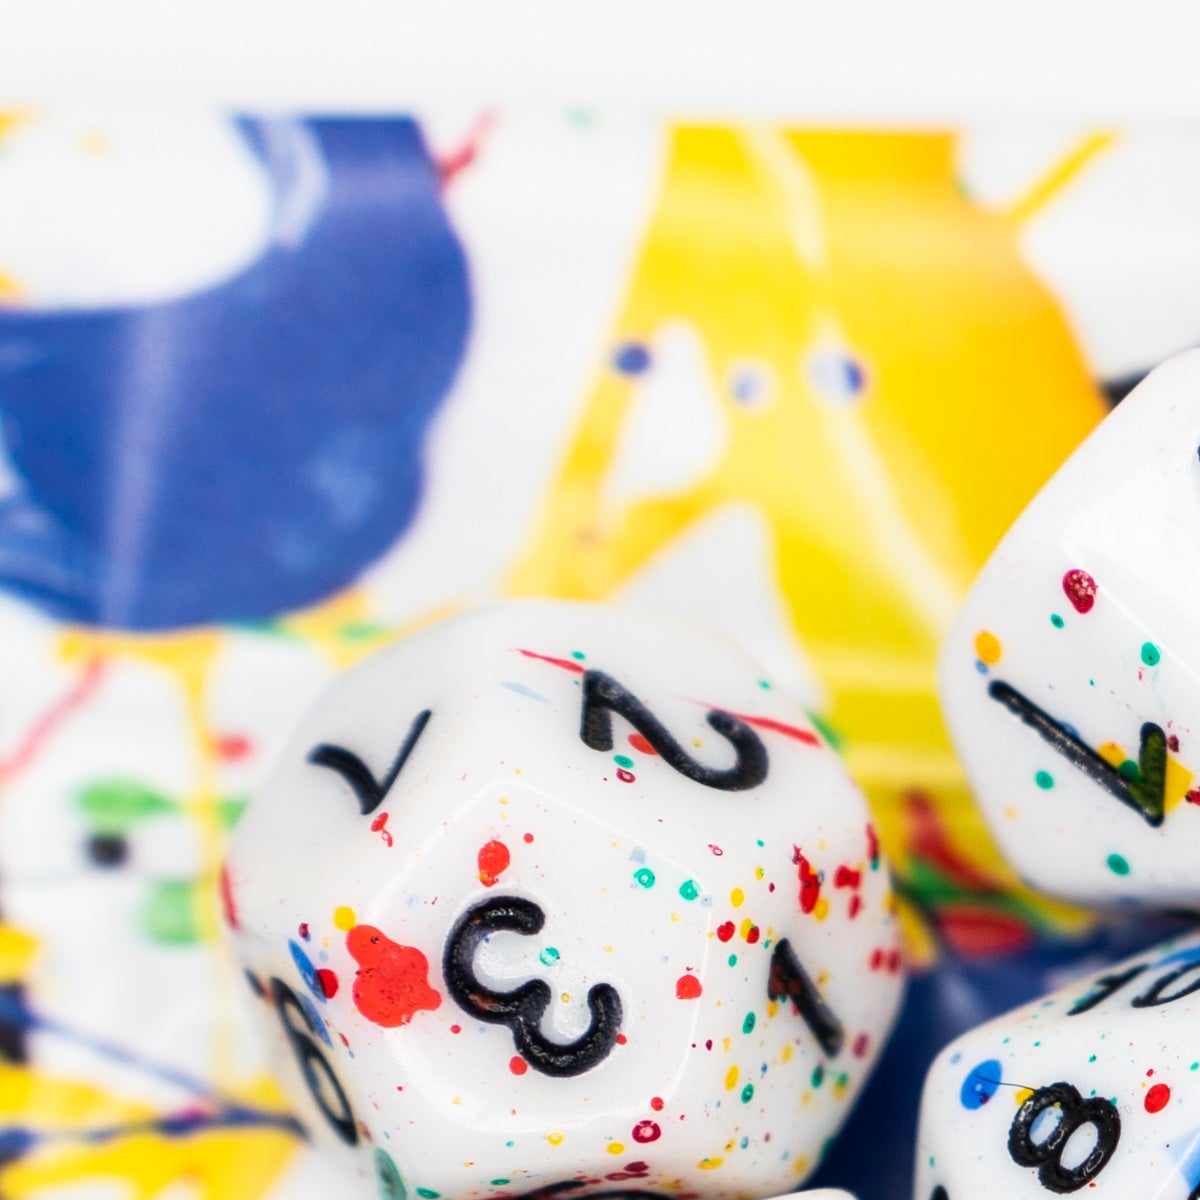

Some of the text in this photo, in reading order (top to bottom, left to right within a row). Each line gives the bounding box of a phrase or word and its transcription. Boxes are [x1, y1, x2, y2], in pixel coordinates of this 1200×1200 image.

[579, 669, 769, 792] 2
[442, 896, 625, 1078] 3
[767, 938, 843, 1058] 1
[1007, 1082, 1122, 1194] 8
